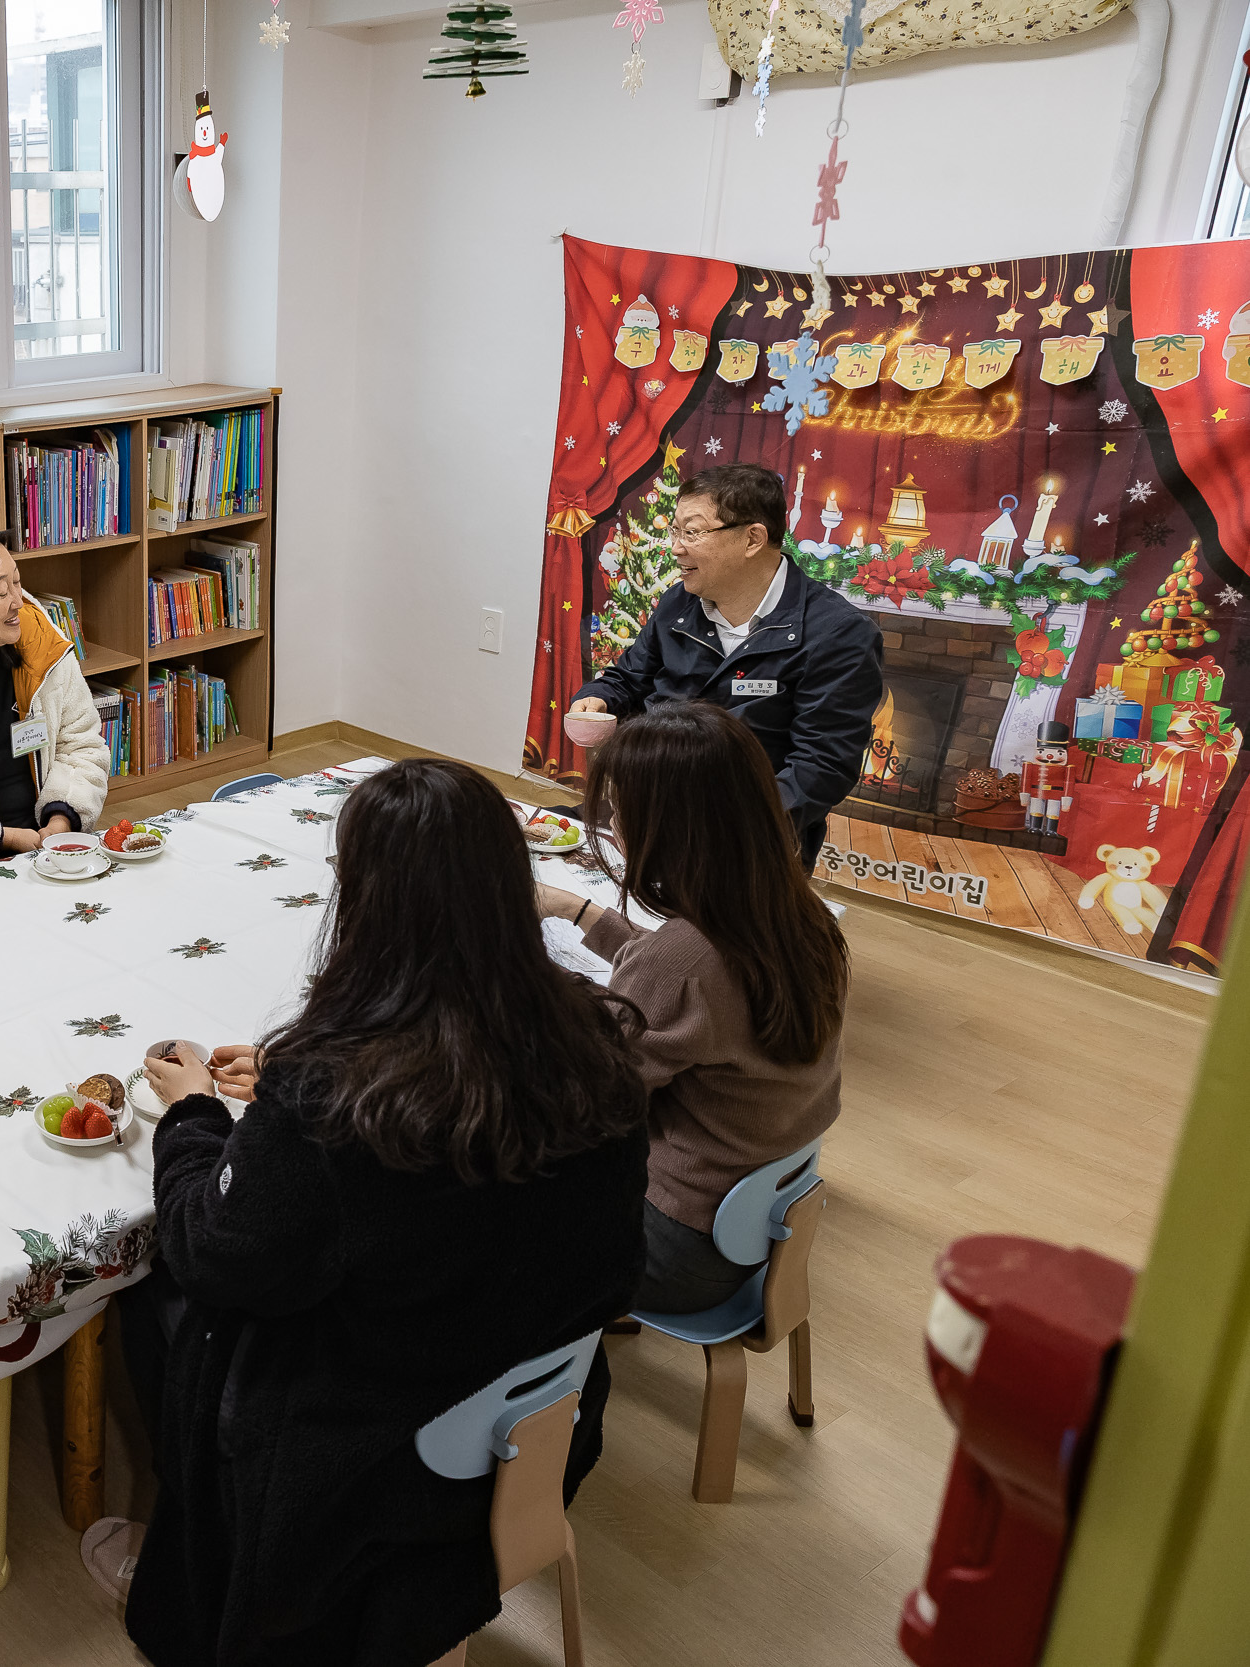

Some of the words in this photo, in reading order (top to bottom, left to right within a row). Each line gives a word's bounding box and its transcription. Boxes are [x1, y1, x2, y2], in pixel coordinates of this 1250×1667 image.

[630, 342, 643, 358] 구
[684, 345, 696, 366] 청
[732, 355, 746, 375] 장
[847, 363, 868, 378] 과
[911, 361, 931, 384] 함
[1058, 359, 1080, 375] 해
[1157, 356, 1174, 377] 요
[822, 845, 985, 905] 중앙어린이집
